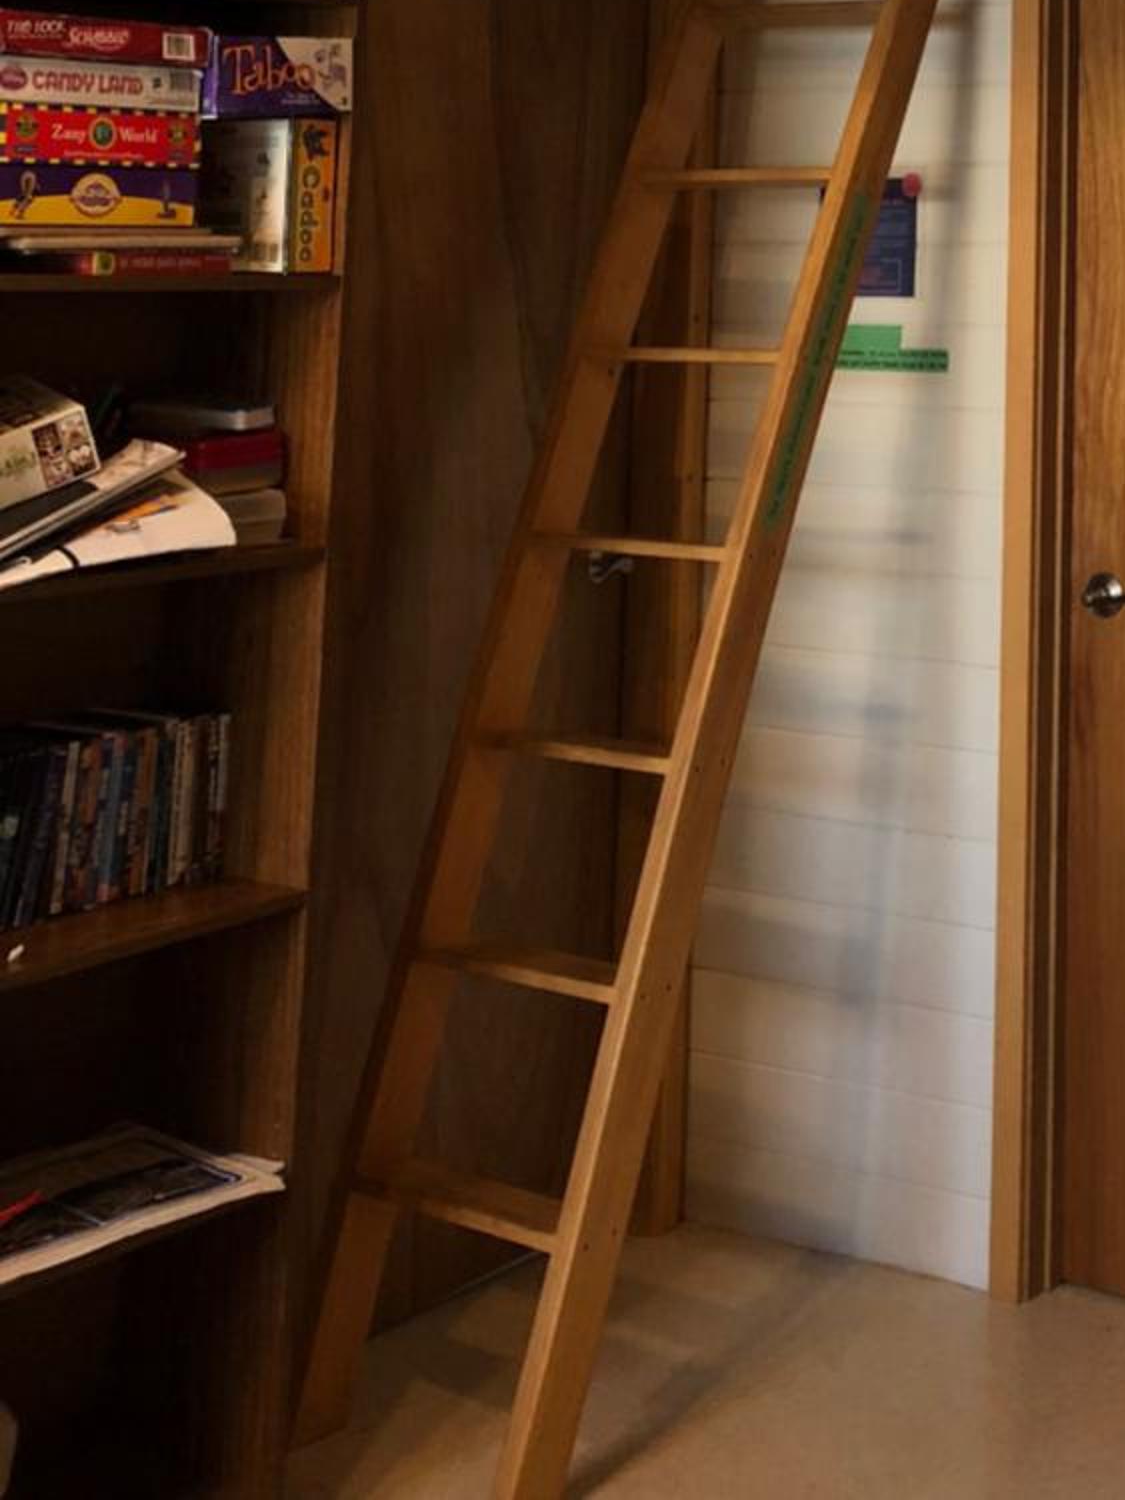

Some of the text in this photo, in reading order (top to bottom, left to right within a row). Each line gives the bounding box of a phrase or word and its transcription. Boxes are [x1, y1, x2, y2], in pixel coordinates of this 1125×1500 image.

[32, 69, 96, 93] CANDY
[98, 73, 144, 96] LAND
[222, 45, 316, 95] Taboo
[51, 122, 157, 143] Zany World
[300, 165, 320, 262] Cadoo
